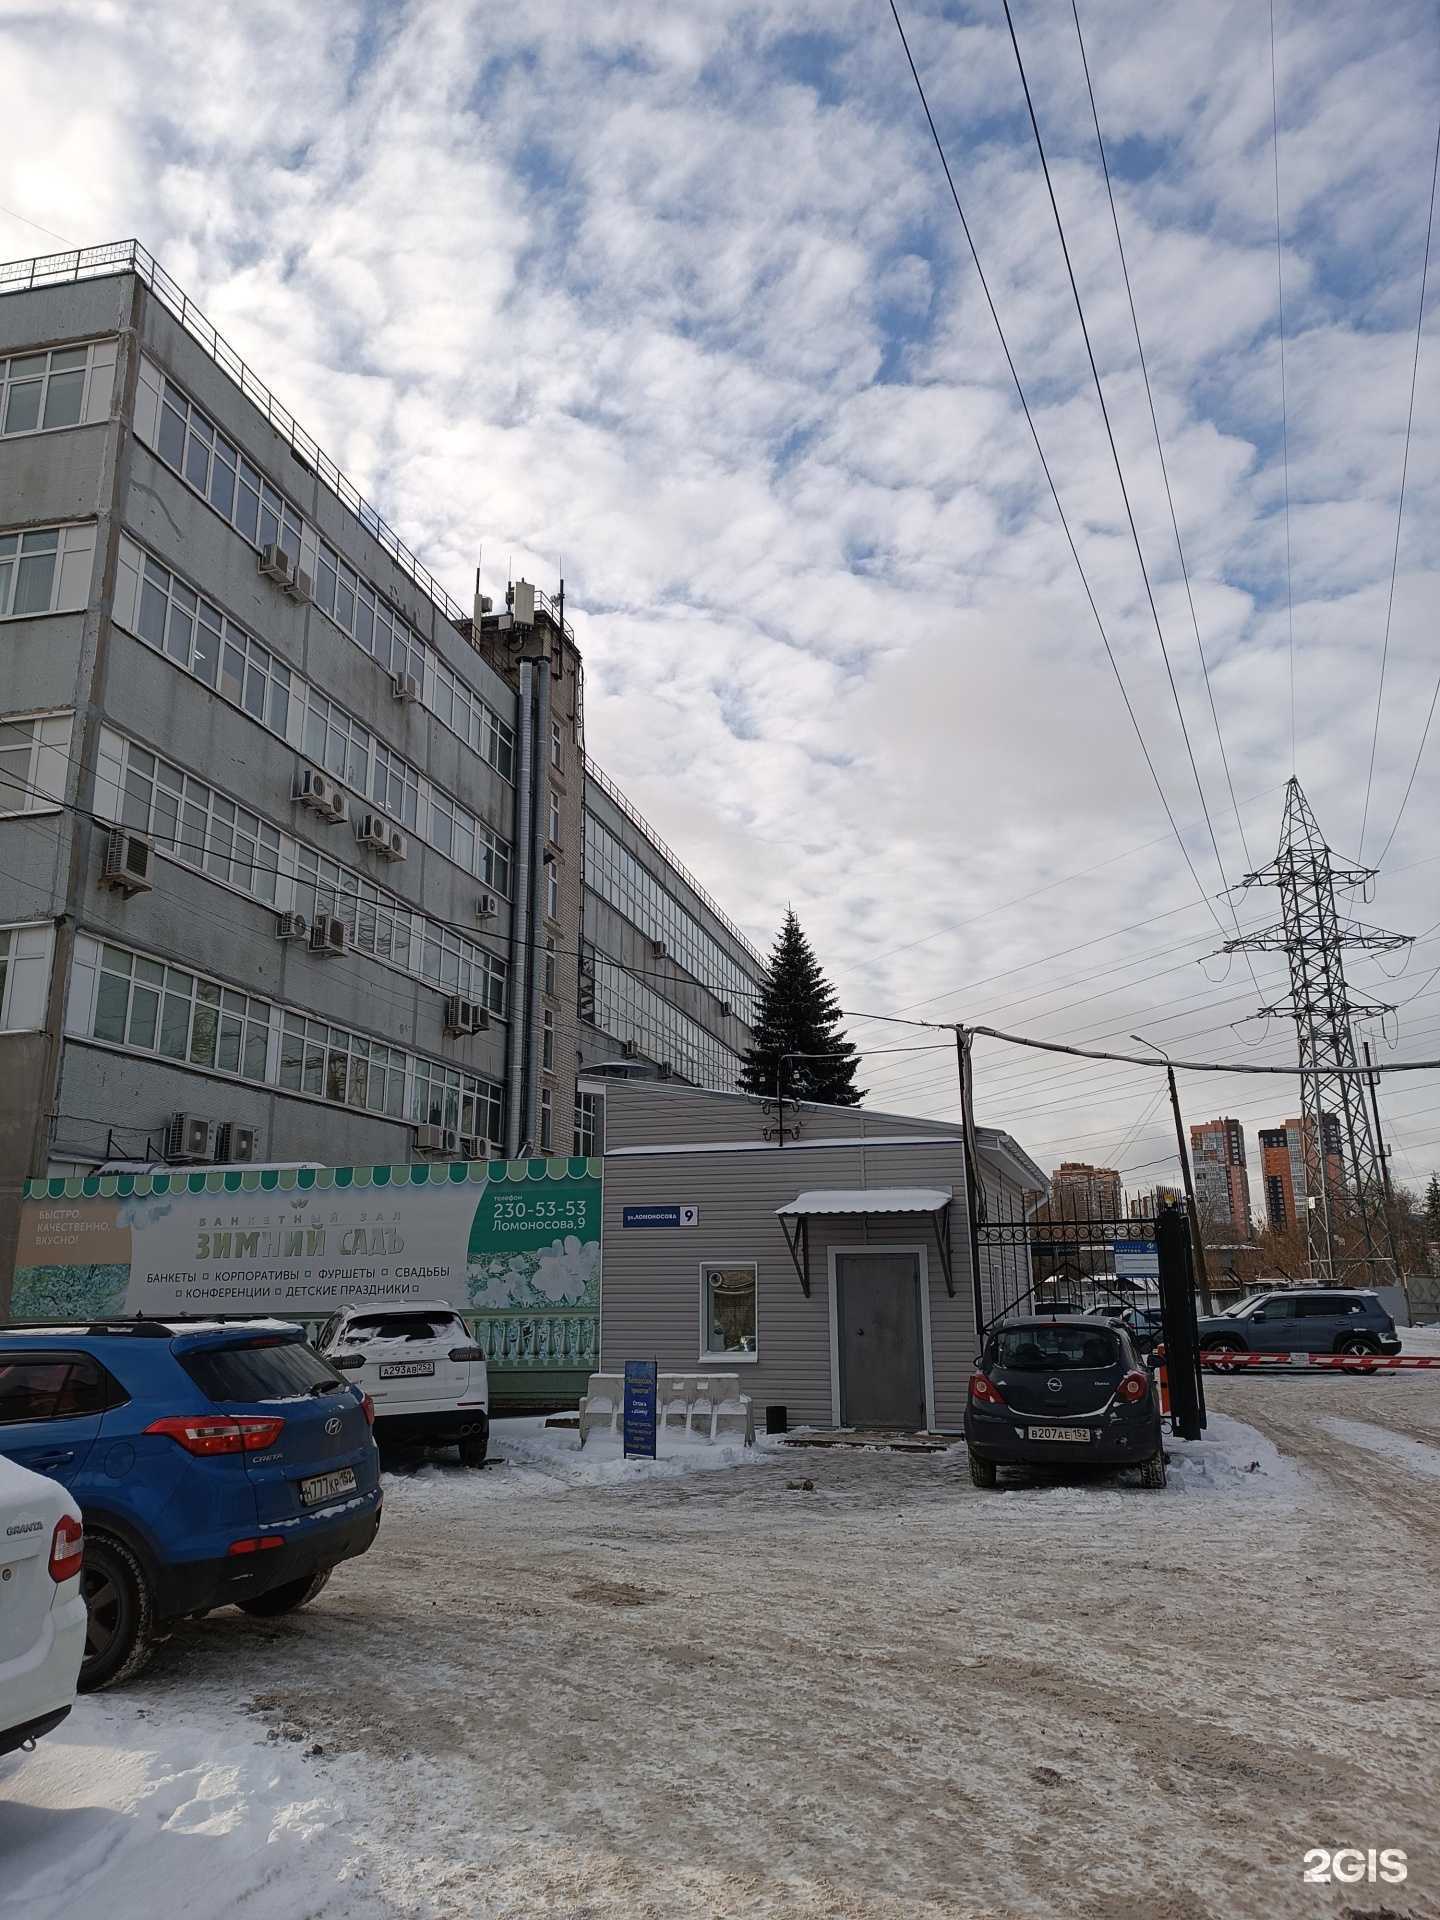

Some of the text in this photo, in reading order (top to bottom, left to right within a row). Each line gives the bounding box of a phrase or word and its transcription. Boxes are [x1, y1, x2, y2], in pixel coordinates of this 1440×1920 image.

[360, 1211, 402, 1223] ЗАЛ
[493, 1200, 586, 1218] 230-53-53
[684, 1209, 694, 1222] 9
[492, 1216, 586, 1232] Ломоносова,9
[195, 1223, 405, 1260] ЗИМНИЙ САДЪ
[146, 1266, 450, 1283] БАНКЕТЫ КОРПОРАТИВЫ ФУРШЕТЫ СВАДЬБЫ
[185, 1283, 411, 1299] КОНФЕРЕНЦИИ ДЕТСКИЕ ПРАЗДНИКИ
